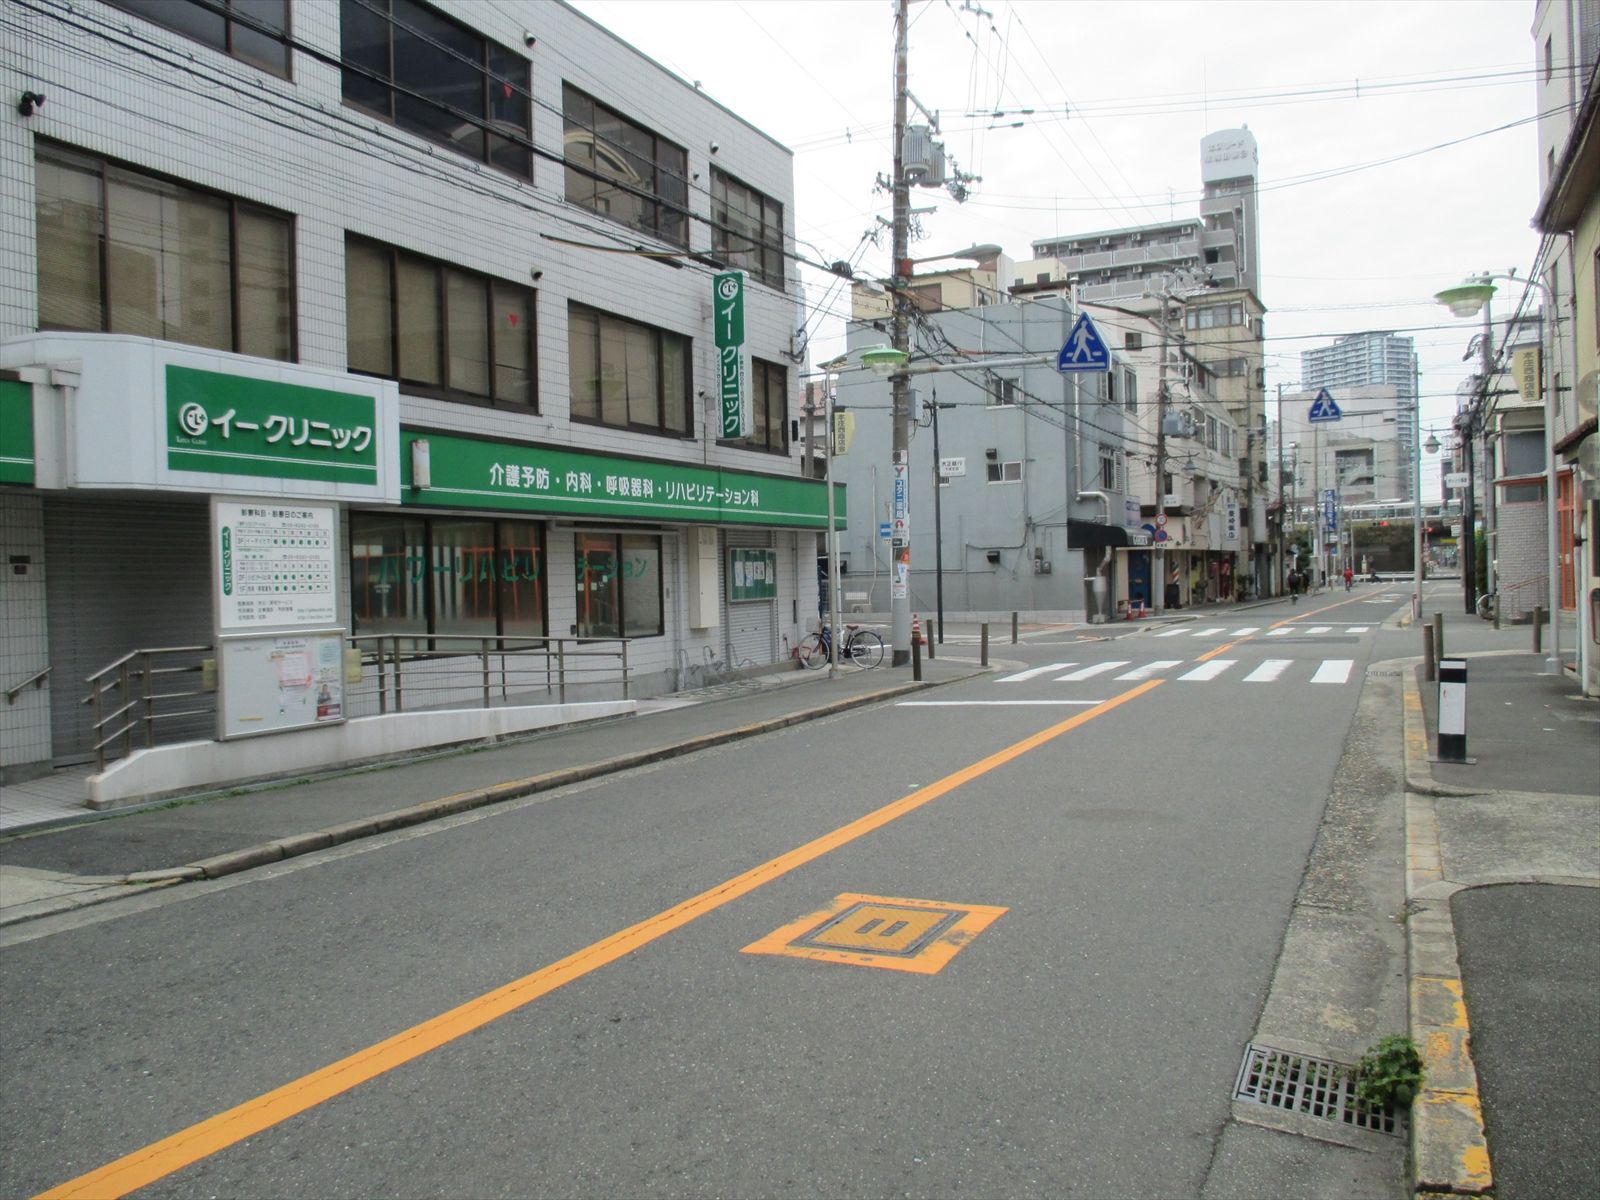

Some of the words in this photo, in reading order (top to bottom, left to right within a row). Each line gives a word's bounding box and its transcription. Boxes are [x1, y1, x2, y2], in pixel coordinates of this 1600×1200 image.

[722, 302, 739, 433] イークリニック
[211, 408, 372, 453] イークリニック
[489, 462, 759, 507] 介護予防・内科・呼吸器科・リハビリテーション科
[223, 530, 232, 591] イークリニック
